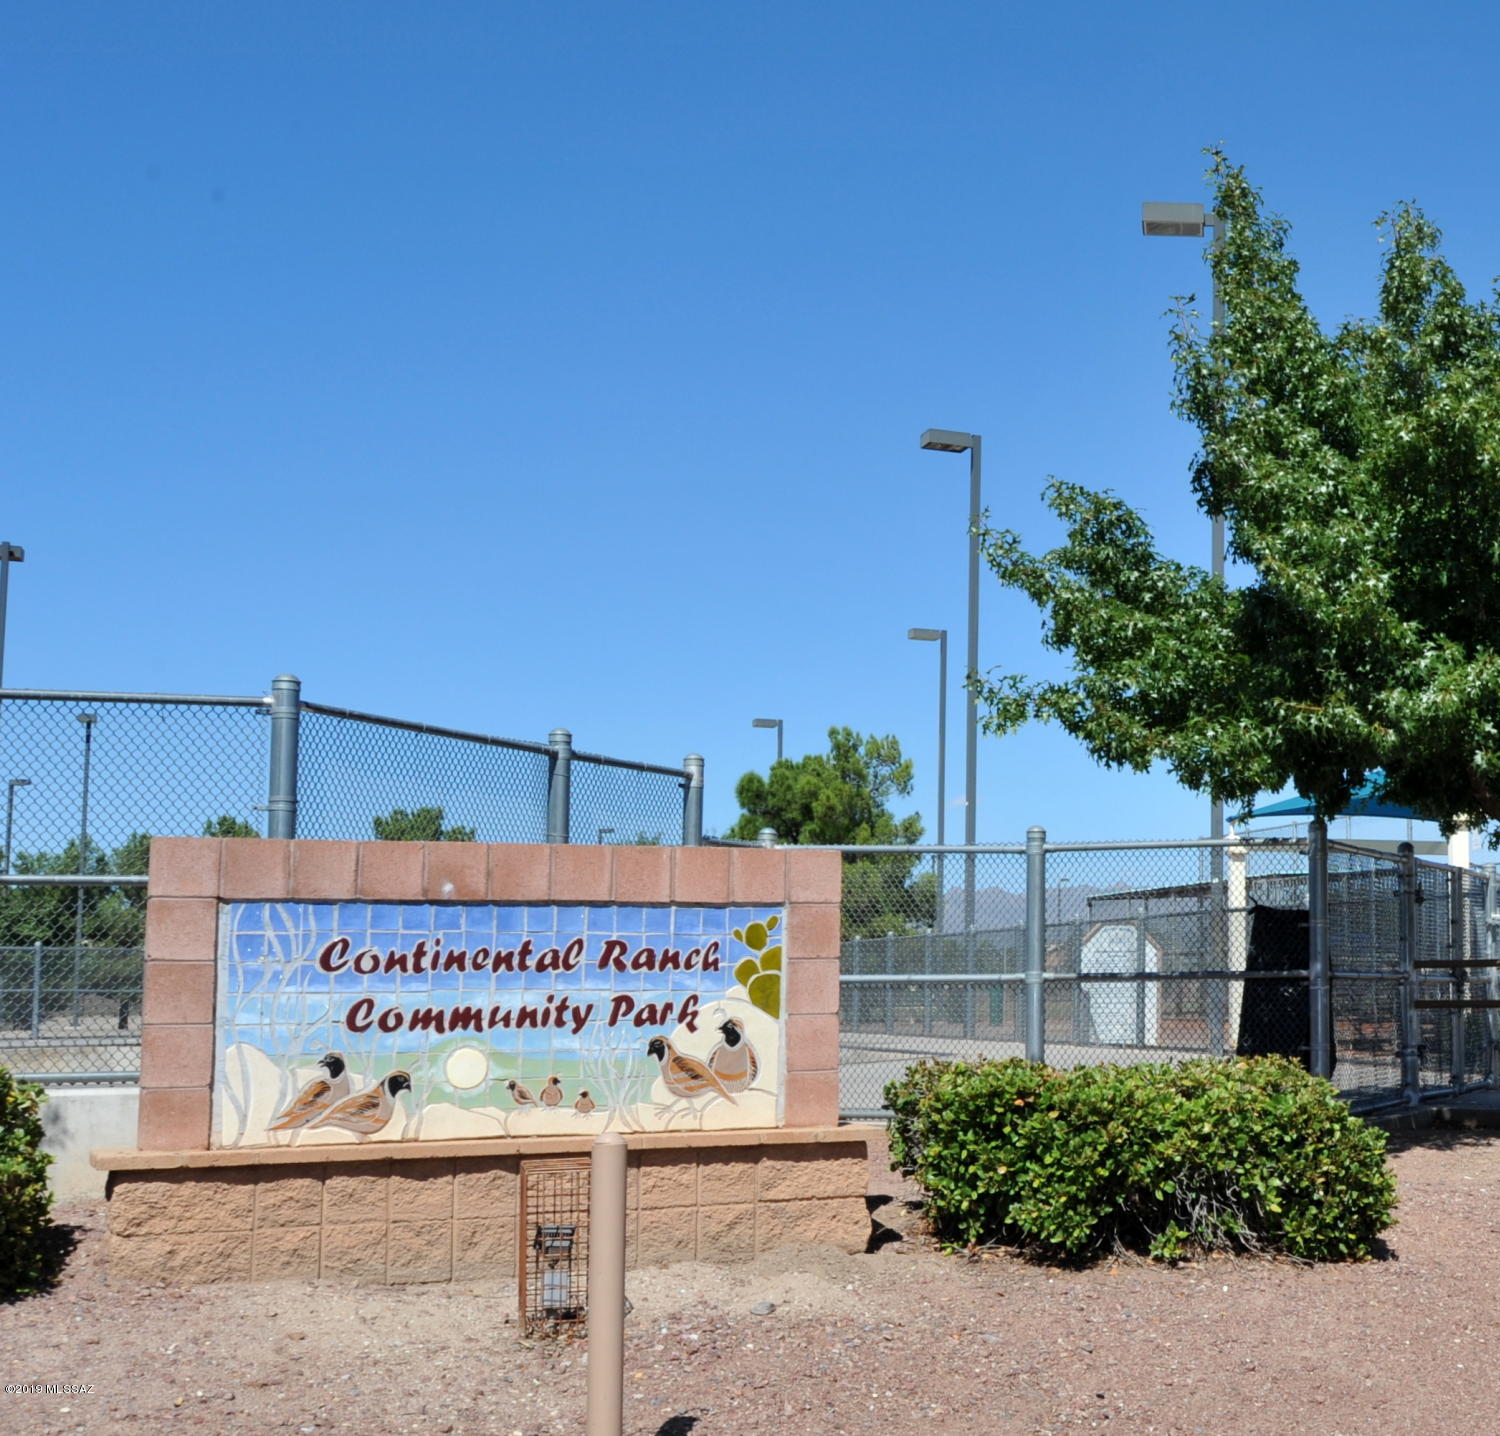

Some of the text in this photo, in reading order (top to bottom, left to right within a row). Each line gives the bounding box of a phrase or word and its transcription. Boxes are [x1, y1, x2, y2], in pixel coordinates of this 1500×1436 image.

[317, 936, 721, 975] Continental Ranch
[344, 993, 700, 1035] Community Park
